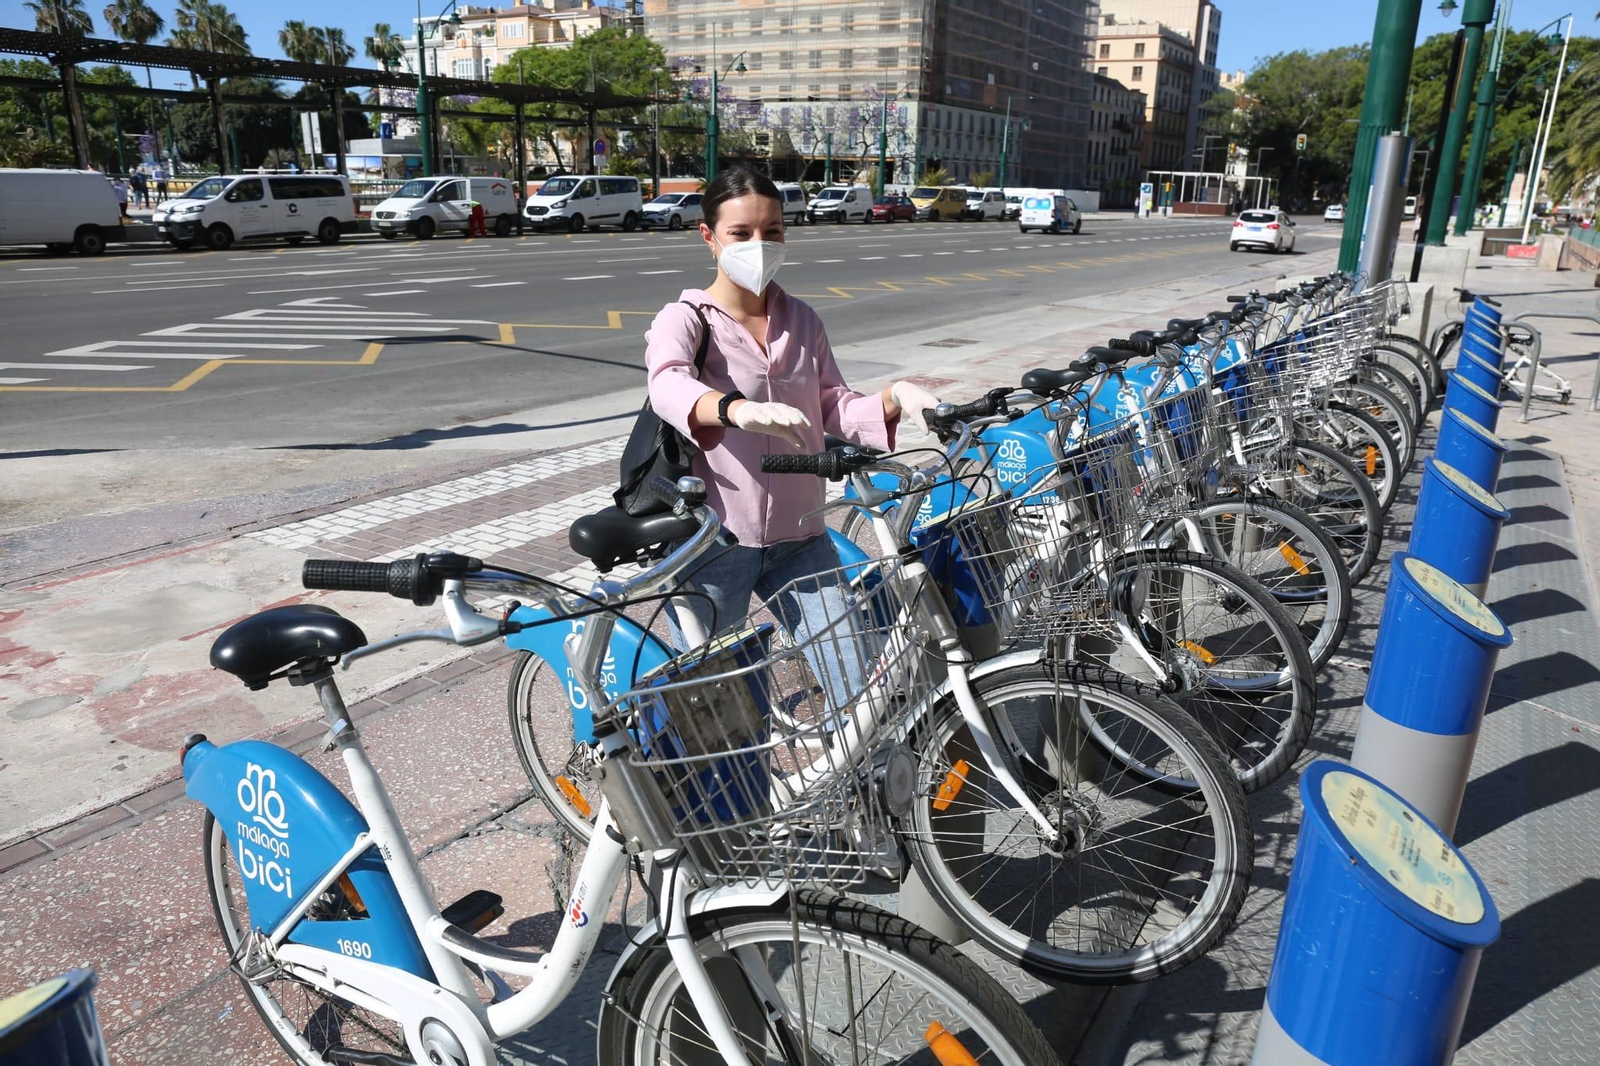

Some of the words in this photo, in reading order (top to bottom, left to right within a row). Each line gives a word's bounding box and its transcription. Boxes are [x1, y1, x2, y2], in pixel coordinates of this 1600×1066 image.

[997, 461, 1027, 470] málaga
[997, 468, 1027, 483] bici
[237, 821, 290, 858] málaga
[238, 839, 293, 899] bici
[337, 938, 372, 959] 1690
